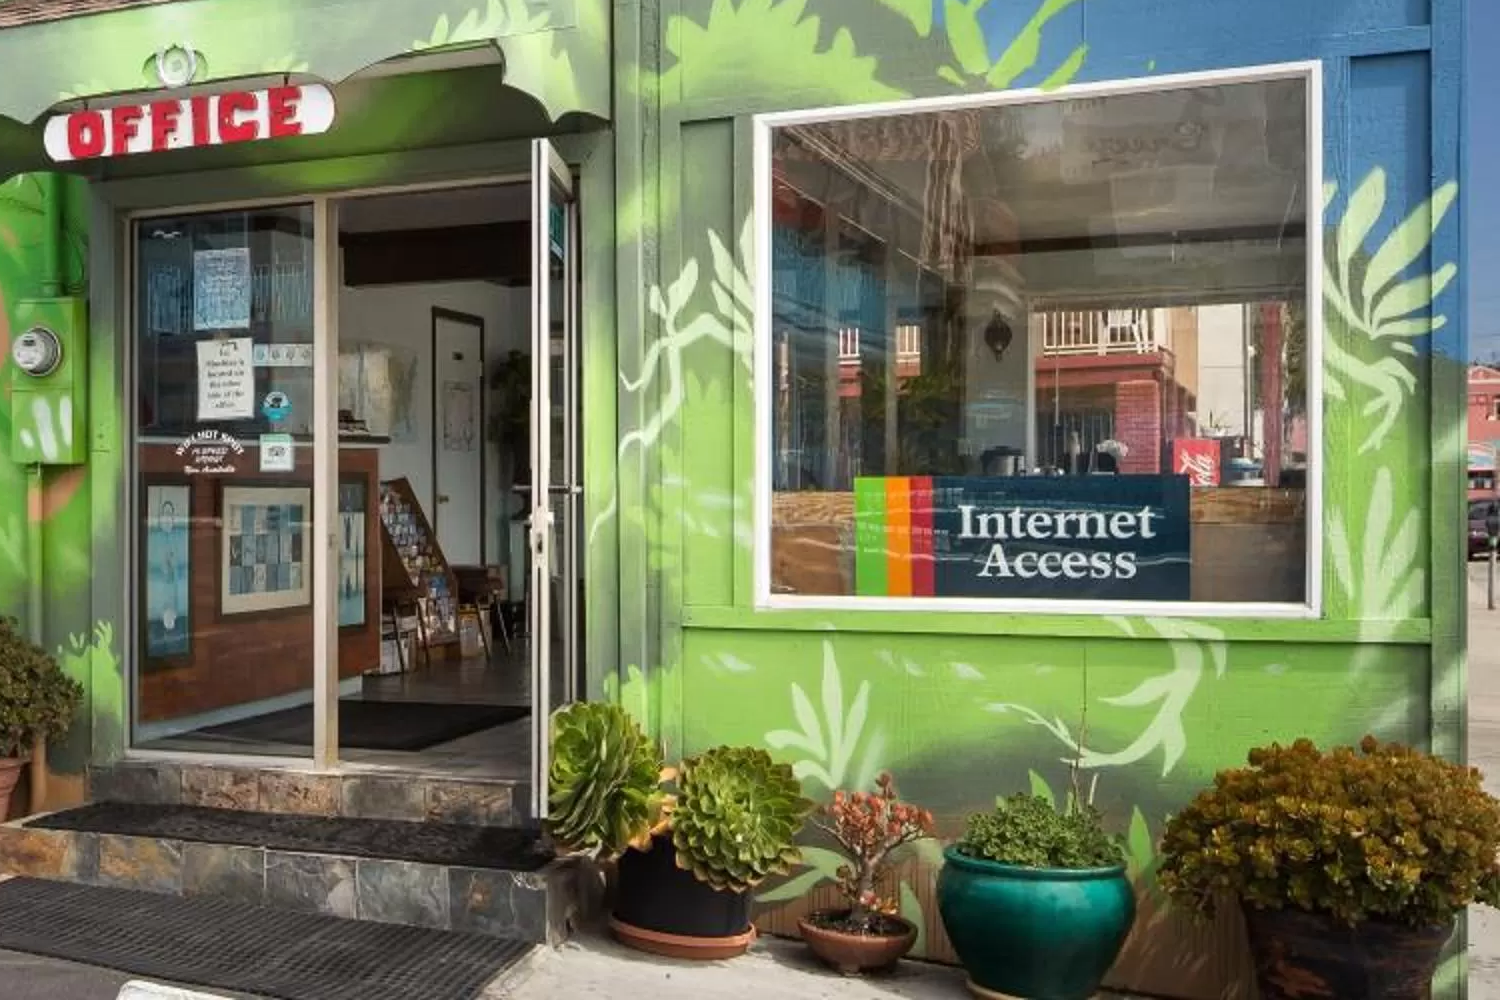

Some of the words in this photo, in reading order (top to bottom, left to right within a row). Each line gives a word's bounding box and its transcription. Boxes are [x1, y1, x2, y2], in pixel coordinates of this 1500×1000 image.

[67, 86, 304, 160] OFFICE
[957, 504, 1156, 540] Internet
[976, 543, 1138, 579] Access
